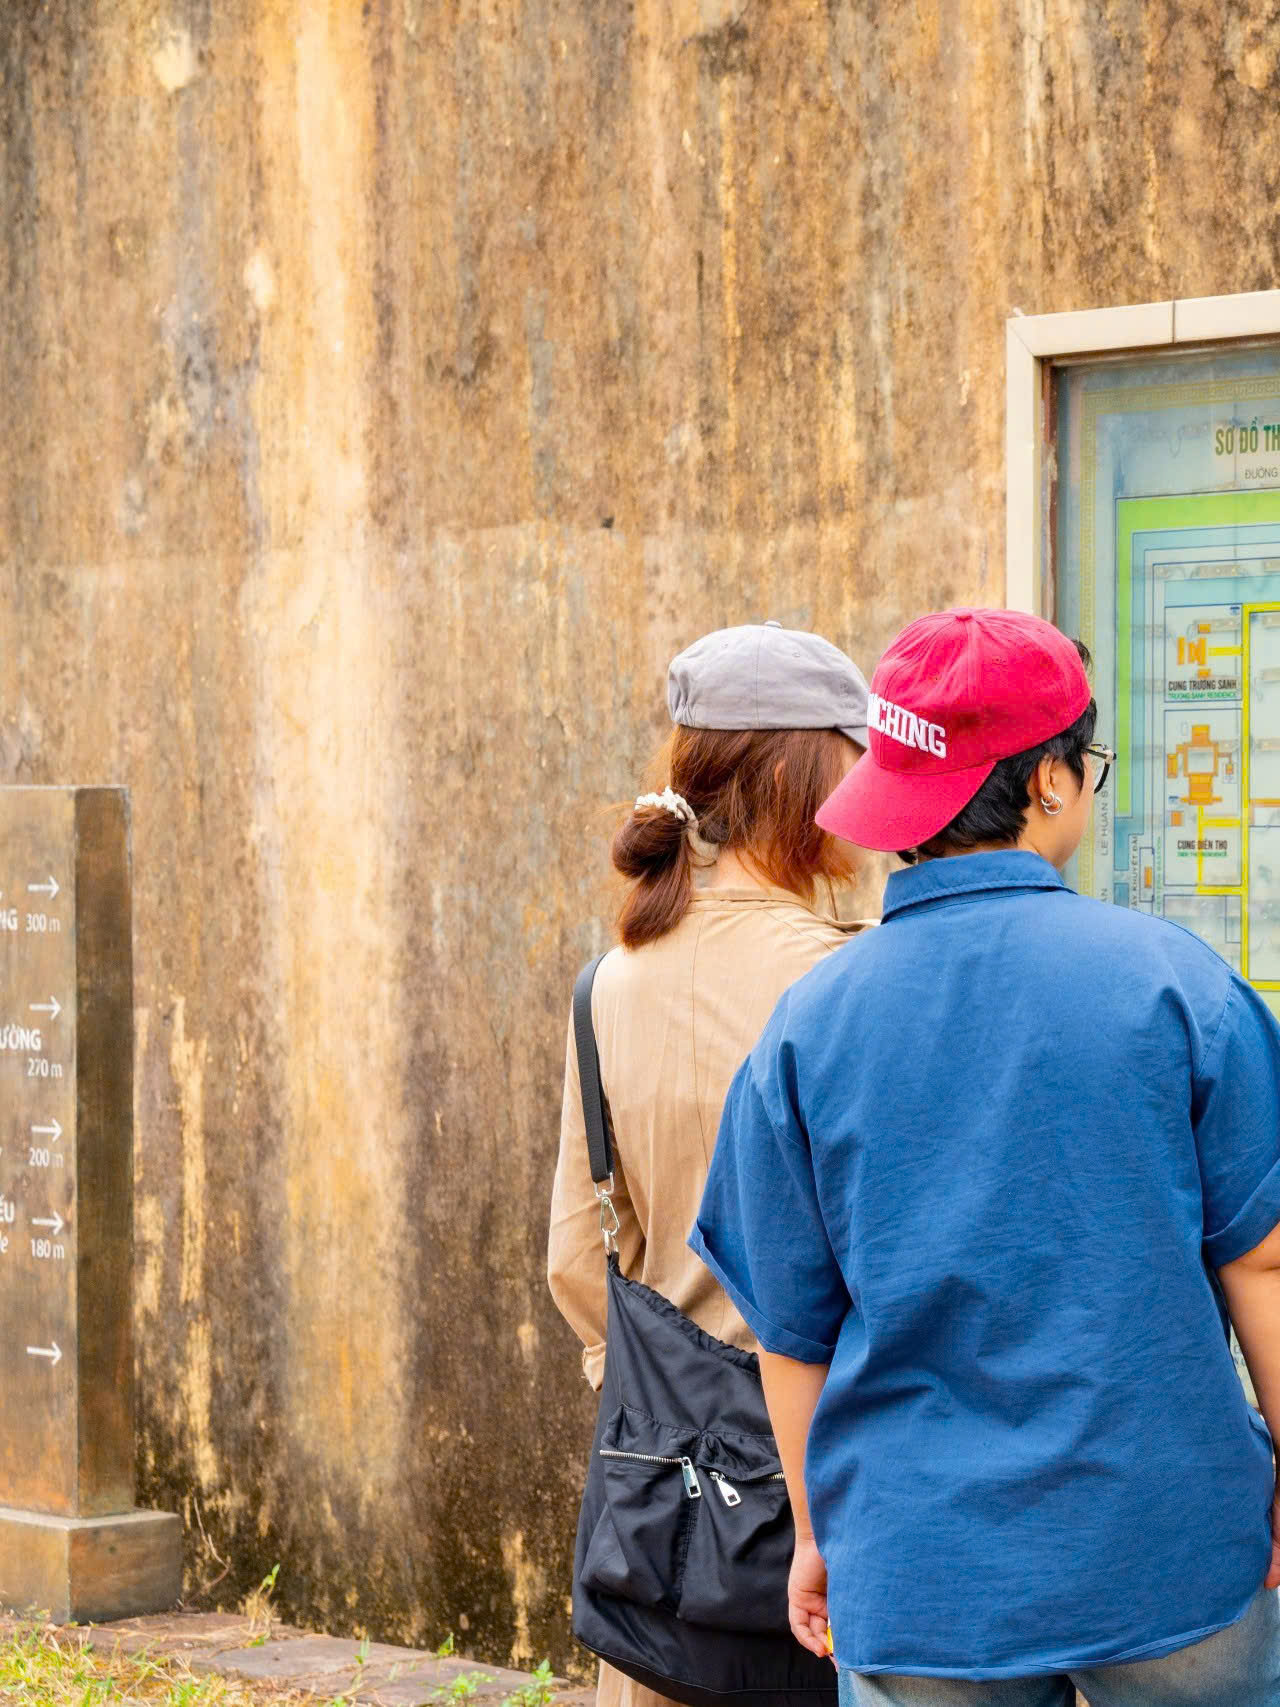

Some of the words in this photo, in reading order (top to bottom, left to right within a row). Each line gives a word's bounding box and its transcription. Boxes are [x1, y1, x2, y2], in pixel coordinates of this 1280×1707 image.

[25, 913, 47, 932] 300
[49, 918, 61, 932] m
[28, 1058, 49, 1077] 270
[51, 1063, 63, 1078] m
[29, 1148, 49, 1167] 200
[52, 1154, 64, 1168] m
[31, 1238, 51, 1259] 180
[52, 1245, 65, 1259] m
